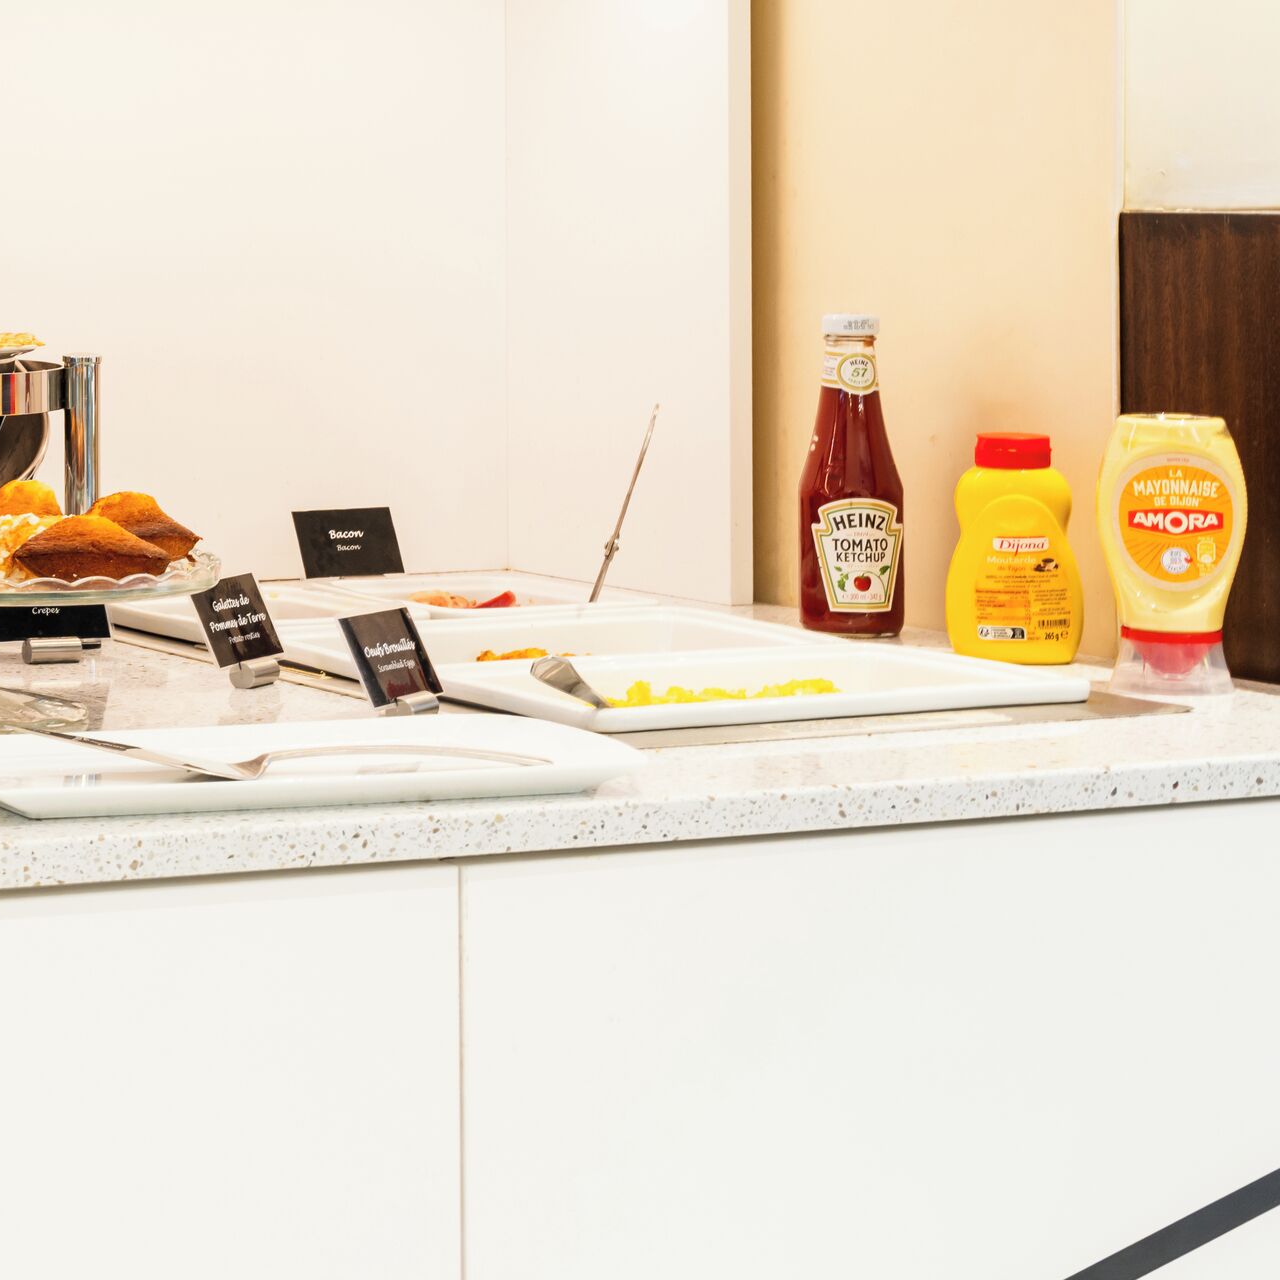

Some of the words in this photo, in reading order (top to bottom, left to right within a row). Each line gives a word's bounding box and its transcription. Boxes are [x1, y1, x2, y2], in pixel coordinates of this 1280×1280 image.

[849, 359, 869, 367] HEINZ
[851, 367, 868, 377] 57
[1169, 468, 1183, 478] LA
[1132, 479, 1220, 499] MAYONNAISE
[1153, 496, 1167, 507] DE
[1169, 496, 1199, 508] DIJON
[832, 512, 886, 531] HEINZ
[1133, 511, 1219, 535] AMORA
[328, 529, 364, 539] Bacon
[831, 538, 889, 552] TOMATO
[999, 539, 1046, 557] Dijona
[836, 551, 886, 563] KETCHUP
[986, 555, 1037, 564] Moutarde
[212, 598, 240, 612] Galettes
[239, 593, 250, 606] de
[209, 619, 239, 633] Pommes
[237, 614, 248, 626] de
[247, 612, 266, 624] Terre
[1044, 632, 1055, 640] 265
[363, 642, 385, 658] Oeufs
[382, 637, 416, 656] Brouillés
[377, 659, 406, 673] Scrambled
[403, 659, 416, 669] Eggs
